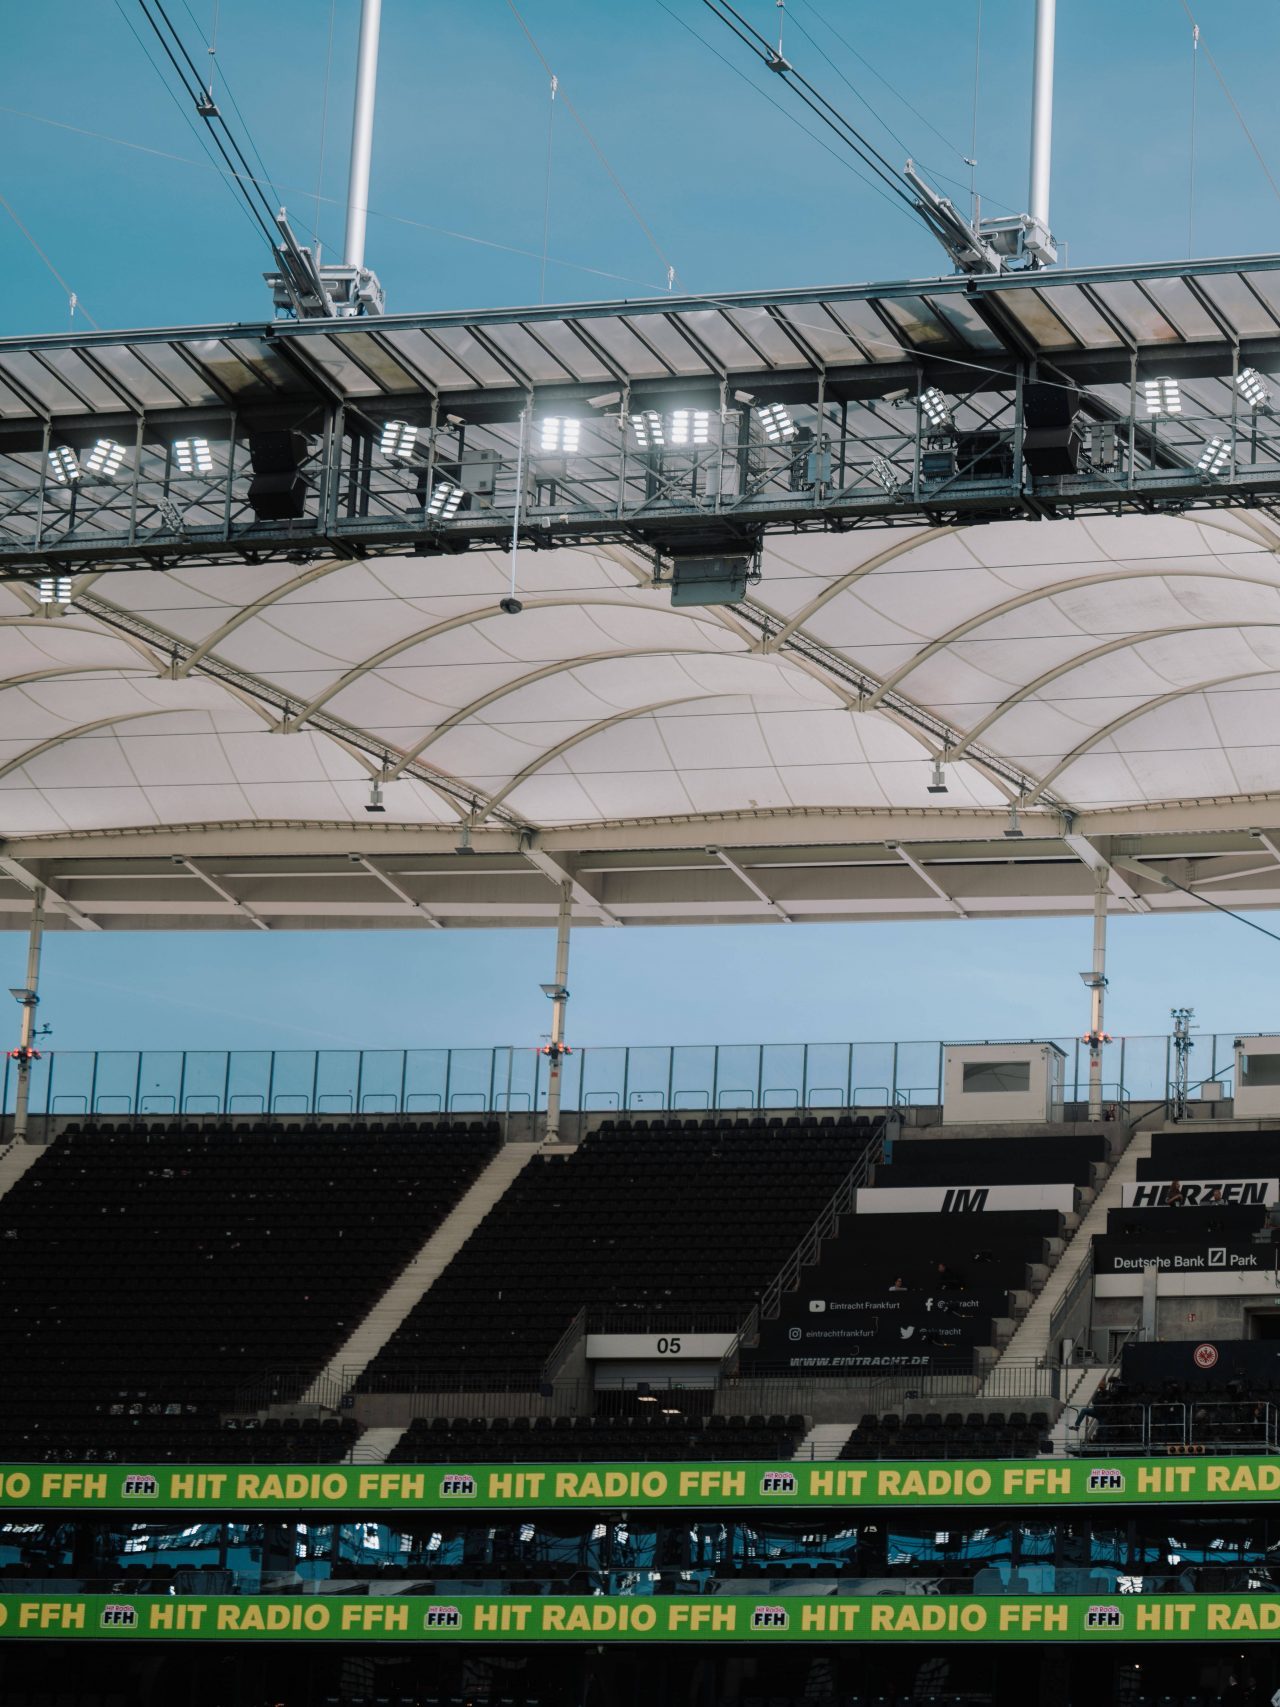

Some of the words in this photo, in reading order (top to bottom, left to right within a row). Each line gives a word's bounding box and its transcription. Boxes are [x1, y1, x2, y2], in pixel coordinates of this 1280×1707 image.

[939, 1188, 990, 1213] IM
[1114, 1256, 1171, 1269] Deutsche
[1174, 1255, 1205, 1268] Bank
[1230, 1254, 1257, 1266] Park
[830, 1302, 864, 1311] Eintracht
[865, 1301, 900, 1310] Frankfurt
[937, 1300, 979, 1310] @racht
[806, 1328, 874, 1339] eintrachtfrankfurt
[919, 1328, 962, 1338] @tracht
[657, 1338, 681, 1354] 05
[789, 1356, 930, 1367] WWW.EINTRACHT.DE
[42, 1473, 107, 1498] FFH
[171, 1474, 227, 1499] HIT
[237, 1473, 347, 1500] RADIO
[359, 1474, 425, 1499] FFH
[489, 1473, 545, 1498] HIT
[555, 1471, 668, 1498] RADIO
[679, 1471, 745, 1497] FFH
[763, 1478, 794, 1491] FFH
[810, 1470, 868, 1496] HIT
[878, 1469, 991, 1496] RADIO
[1003, 1468, 1071, 1495] FFH
[1090, 1475, 1121, 1489] FFH
[1138, 1466, 1195, 1493] HIT
[125, 1481, 155, 1494] FFH
[443, 1481, 473, 1494] FFH
[19, 1603, 85, 1628] FFH
[104, 1611, 134, 1624] FFH
[150, 1604, 207, 1629] HIT
[217, 1604, 330, 1631] RADIO
[342, 1605, 408, 1631] FFH
[427, 1612, 458, 1625] FFH
[474, 1605, 532, 1631] HIT
[542, 1604, 656, 1631] RADIO
[668, 1605, 736, 1631] FFH
[754, 1612, 785, 1626] FFH
[801, 1605, 860, 1631] HIT
[871, 1604, 987, 1632] RADIO
[999, 1604, 1068, 1631] FFH
[1088, 1612, 1120, 1625] FFH
[1136, 1604, 1196, 1631] HIT
